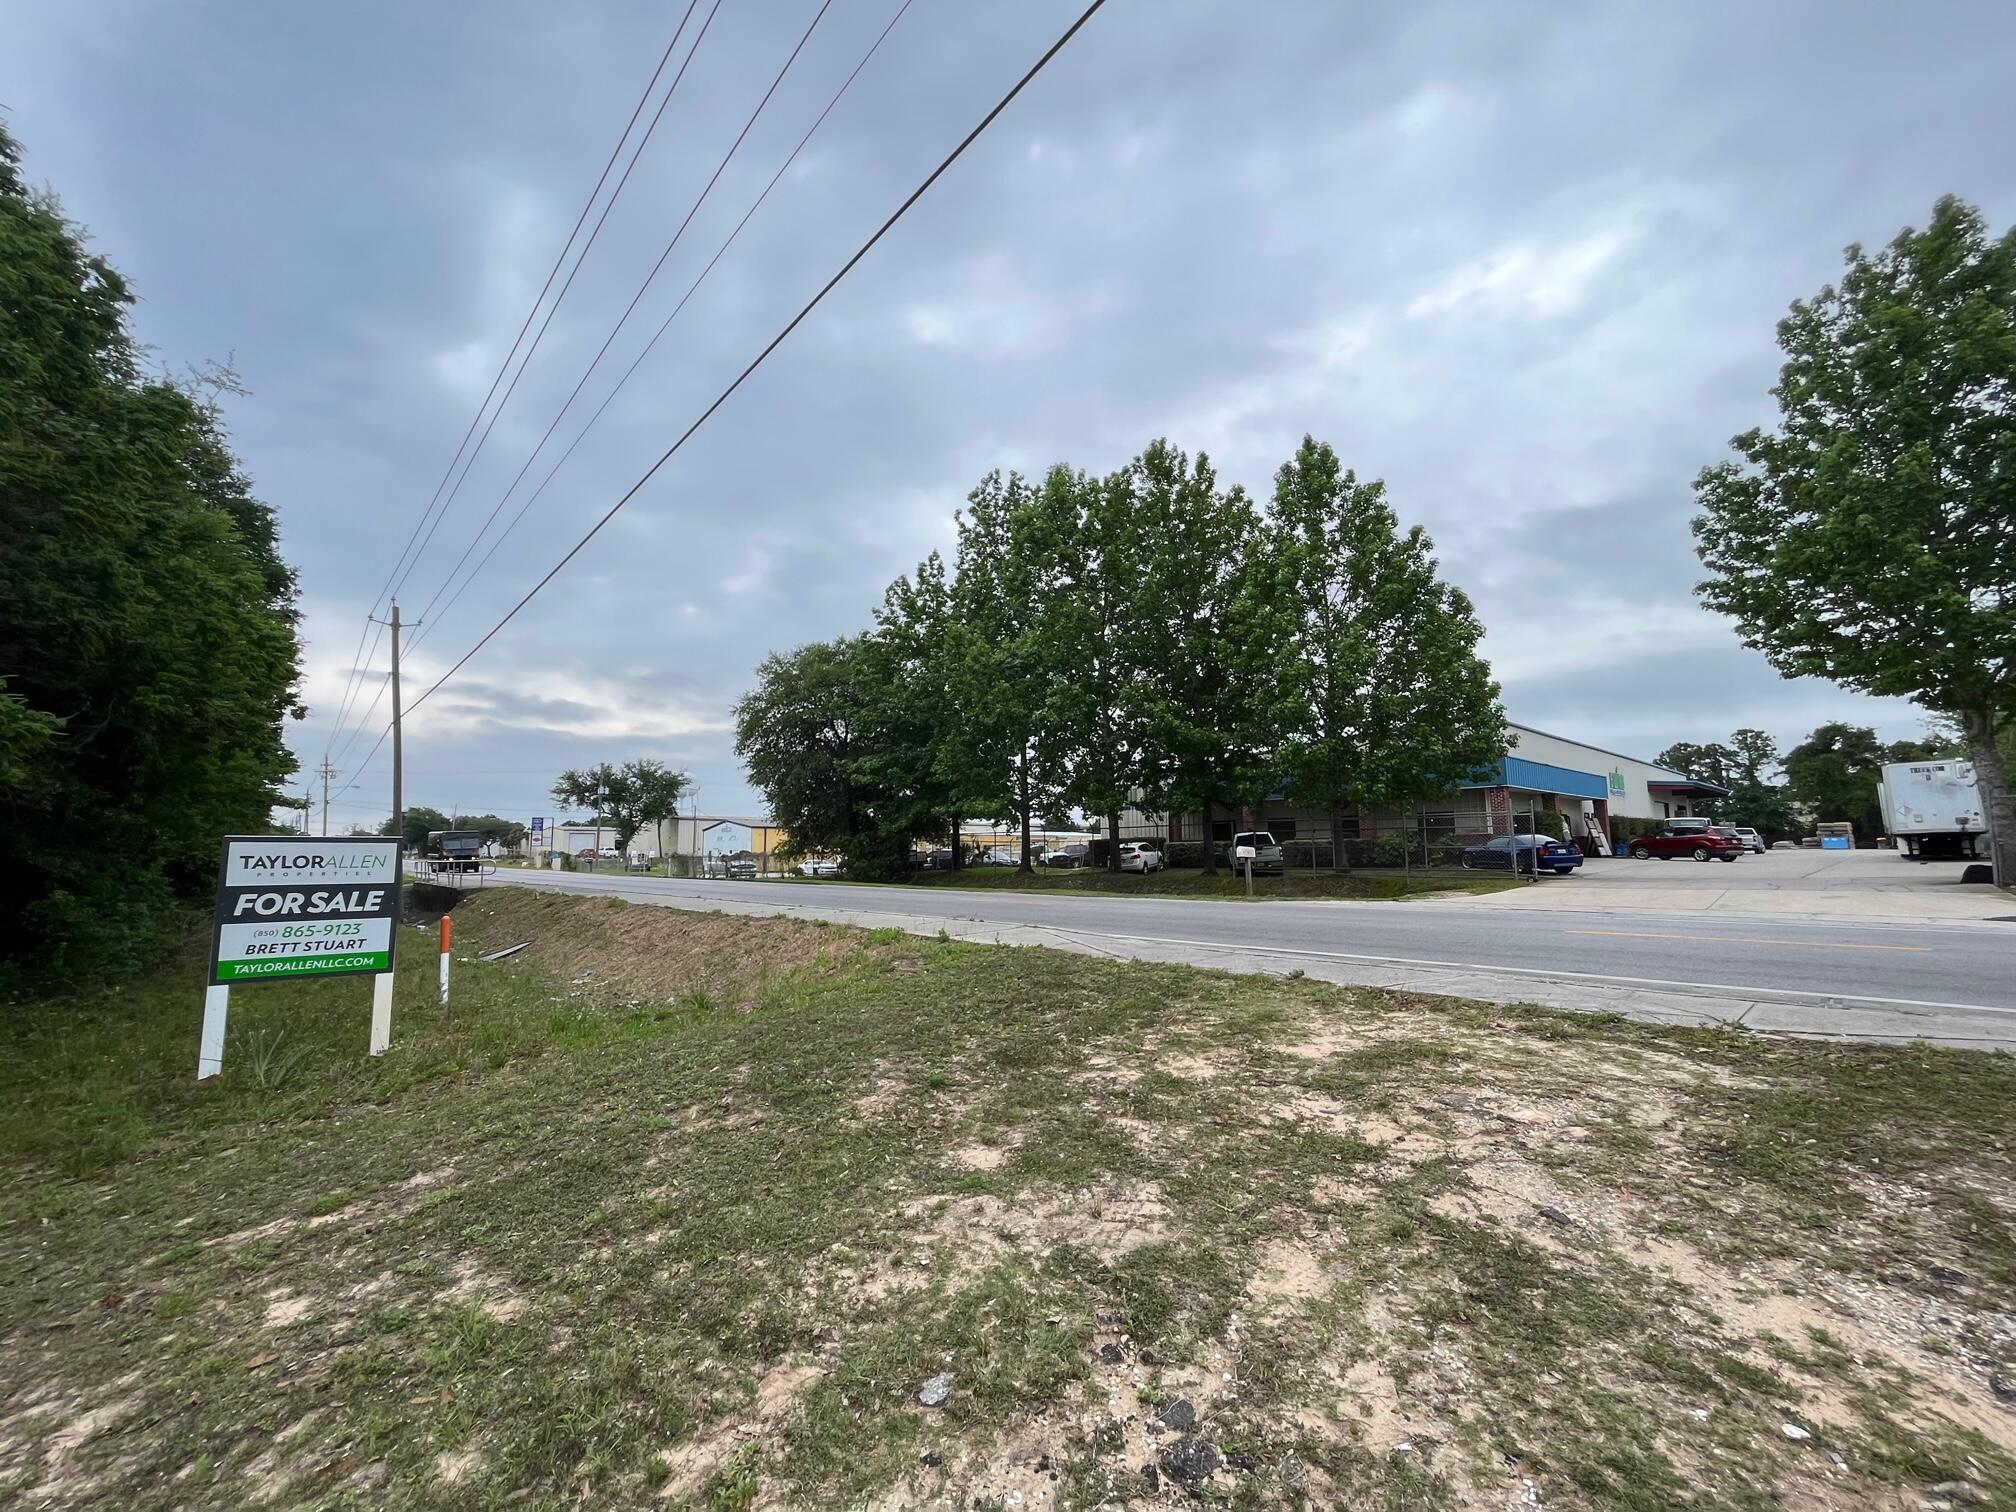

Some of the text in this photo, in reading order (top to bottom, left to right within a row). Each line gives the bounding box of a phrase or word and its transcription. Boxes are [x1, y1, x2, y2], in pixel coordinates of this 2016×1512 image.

[239, 855, 387, 869] TAYLORALLEN
[233, 891, 384, 916] FOR SALE
[253, 923, 362, 938] (850) 865-9123
[245, 938, 367, 955] BRETT STUART
[234, 956, 374, 974] TAYLORALLENLLC.COM
